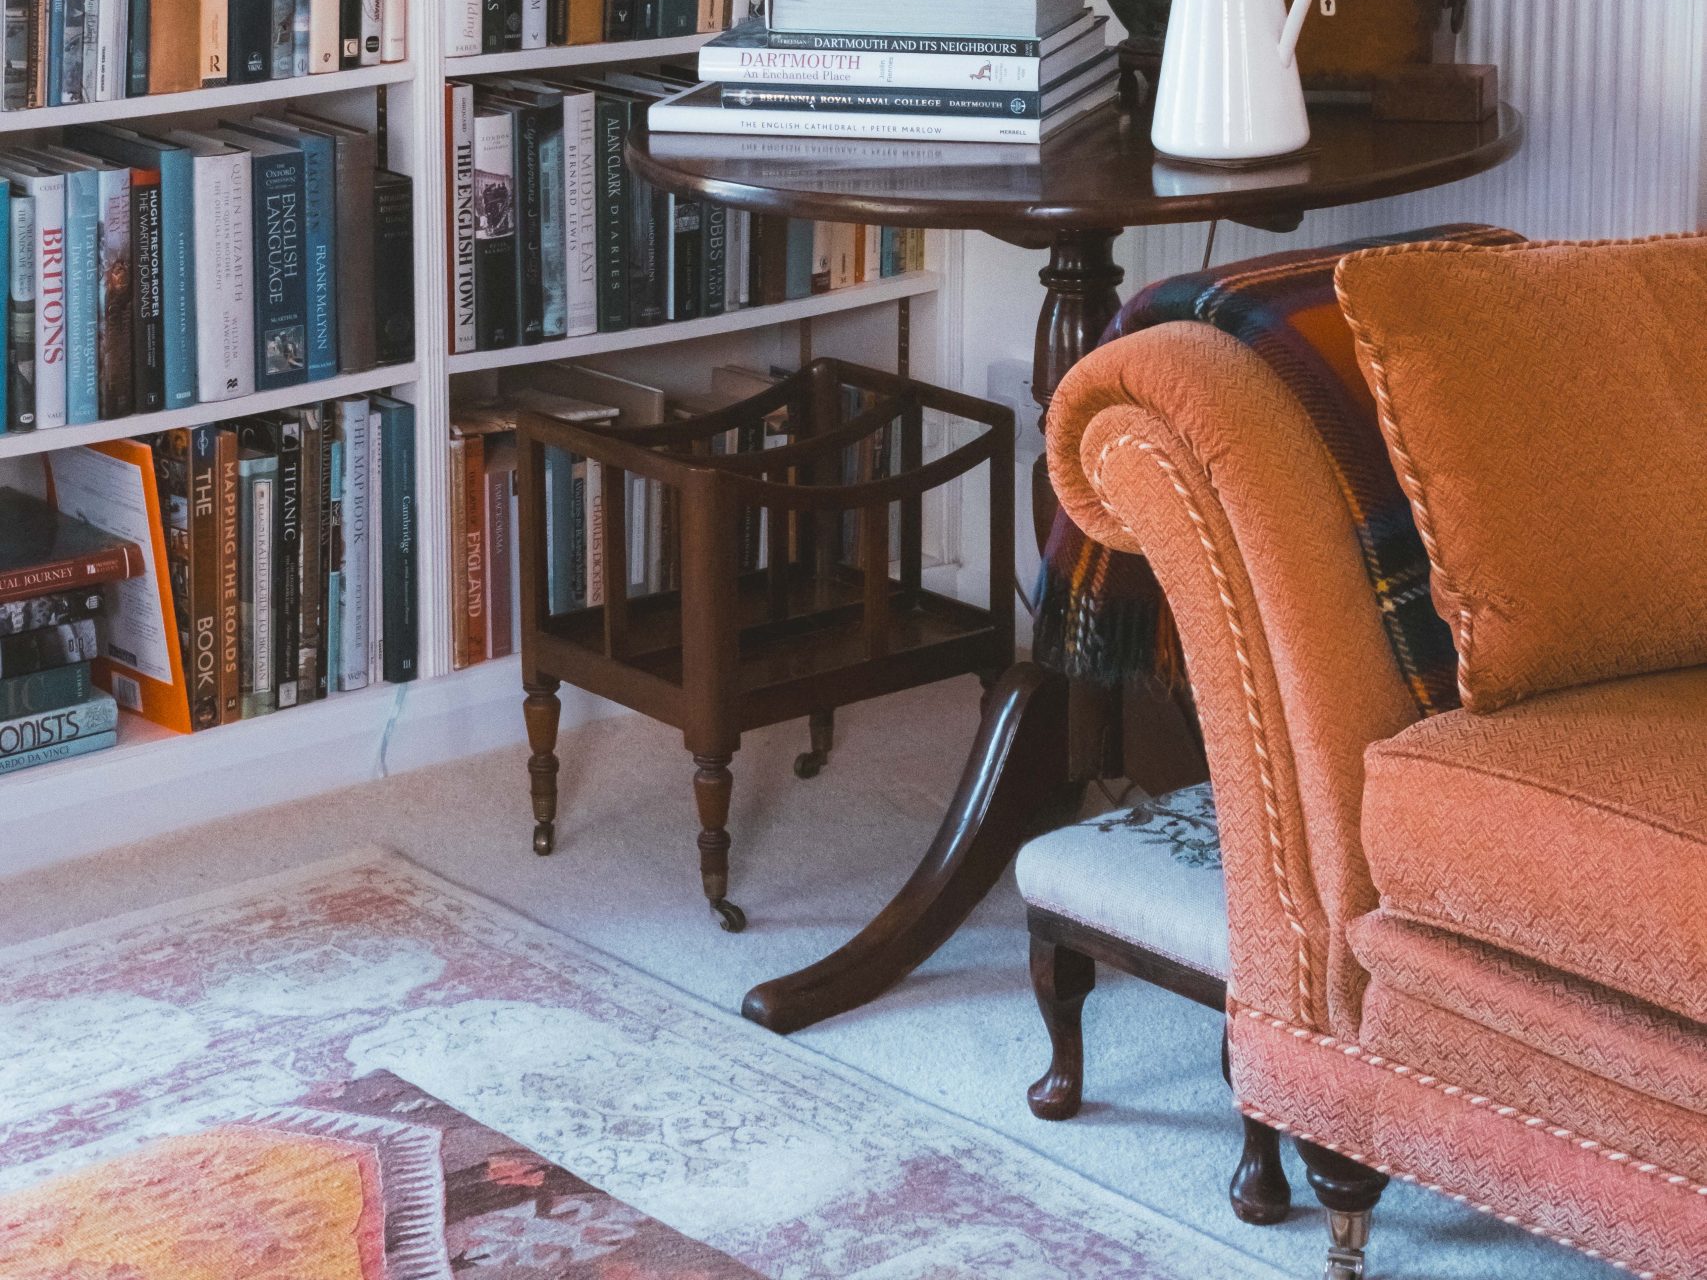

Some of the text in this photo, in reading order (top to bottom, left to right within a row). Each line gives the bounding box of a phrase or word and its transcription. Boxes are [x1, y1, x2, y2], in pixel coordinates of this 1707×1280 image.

[740, 52, 860, 69] DARTMOUTH
[743, 70, 851, 81] An Enchanted Place
[814, 37, 887, 52] DARTMOUTH
[892, 41, 916, 51] AND
[919, 41, 937, 51] ITS
[941, 42, 1016, 54] NEIGHBOURS
[759, 94, 942, 107] BRITANNIA ROYAL NAVAL COLLEGE
[805, 123, 856, 131] CATHEDRAL
[870, 125, 898, 133] PETER
[901, 126, 942, 134] MARLOW
[950, 100, 1002, 108] DARTMOUTH
[150, 189, 158, 226] HUGH
[281, 192, 297, 278] ENGLISH
[457, 140, 474, 327] THE ENGLISH TOWN
[569, 145, 577, 252] BERNARD LEWIS
[607, 118, 621, 291] ALAN CLARK DIARIES
[139, 191, 150, 318] THE WARTIME JOURNALS
[151, 230, 159, 317] TREVOR-ROPER
[266, 195, 283, 305] LANGUAGE
[42, 227, 64, 365] BRITONS
[315, 245, 327, 350] FRANK McLYNN
[283, 462, 297, 542] TITANIC
[353, 415, 364, 545] THE MAP BOOK
[223, 462, 236, 673] MAPPING THE ROADS
[400, 495, 412, 554] Cambridge
[592, 495, 603, 602] CHARLES DICKENS
[24, 567, 73, 586] JOURNEY
[195, 467, 214, 690] THE BOOK
[466, 530, 481, 618] ENGLAND
[27, 754, 40, 763] DA
[43, 746, 69, 758] VINCI
